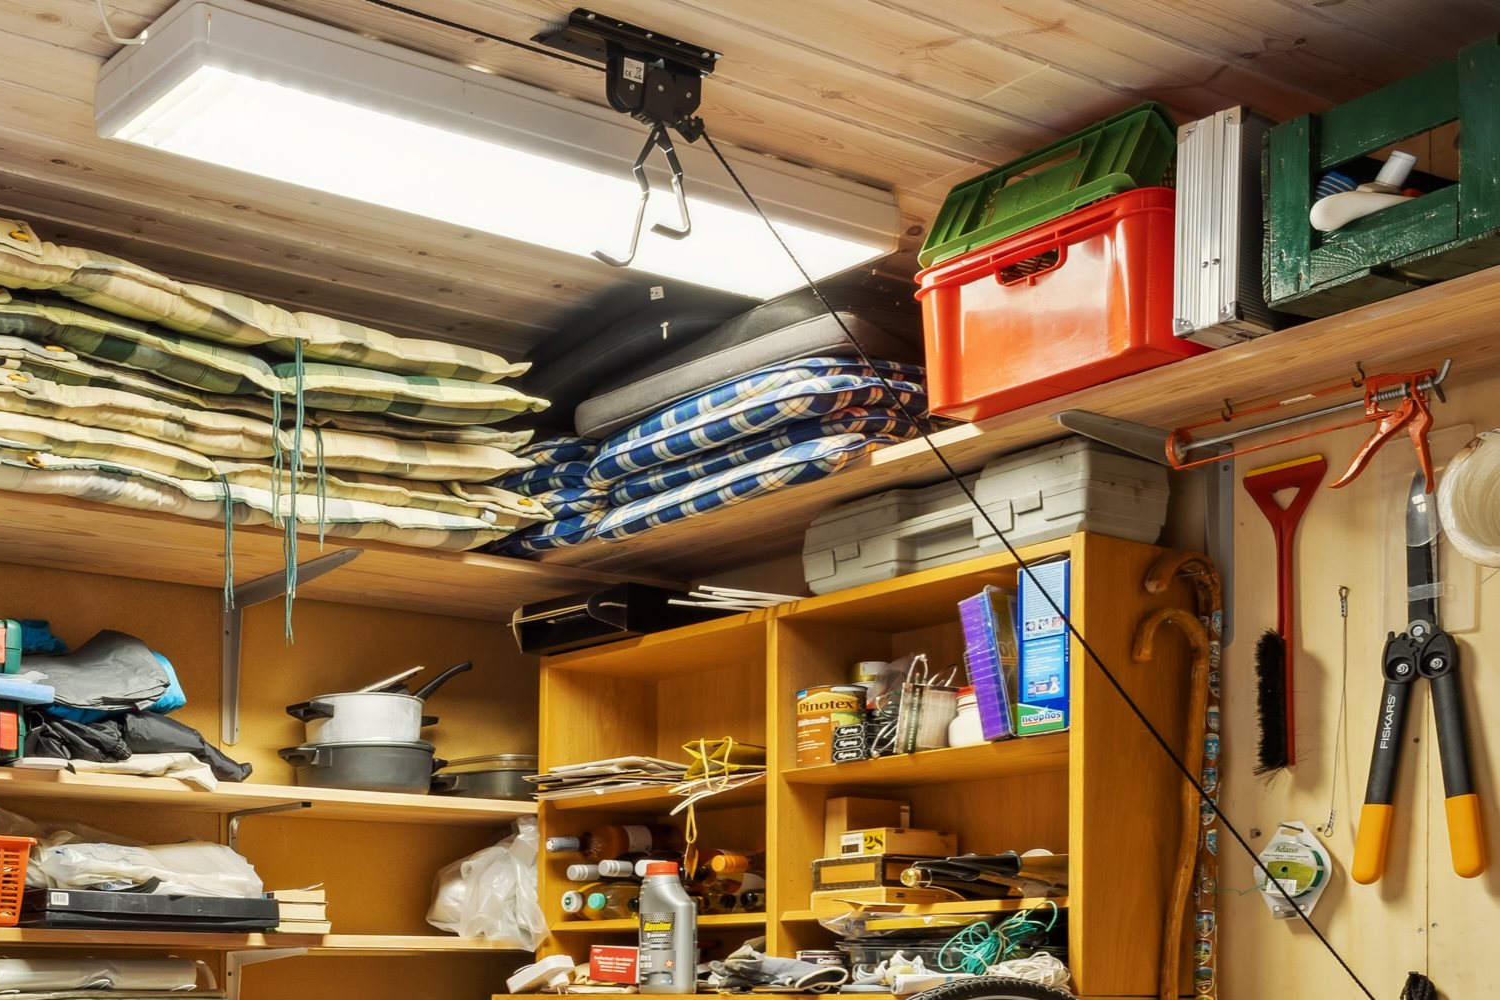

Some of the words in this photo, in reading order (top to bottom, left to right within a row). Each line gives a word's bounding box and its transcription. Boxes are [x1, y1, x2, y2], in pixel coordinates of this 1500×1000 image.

[799, 700, 854, 713] Pinotex
[1021, 710, 1063, 724] neophos
[1380, 694, 1398, 750] FISKARS
